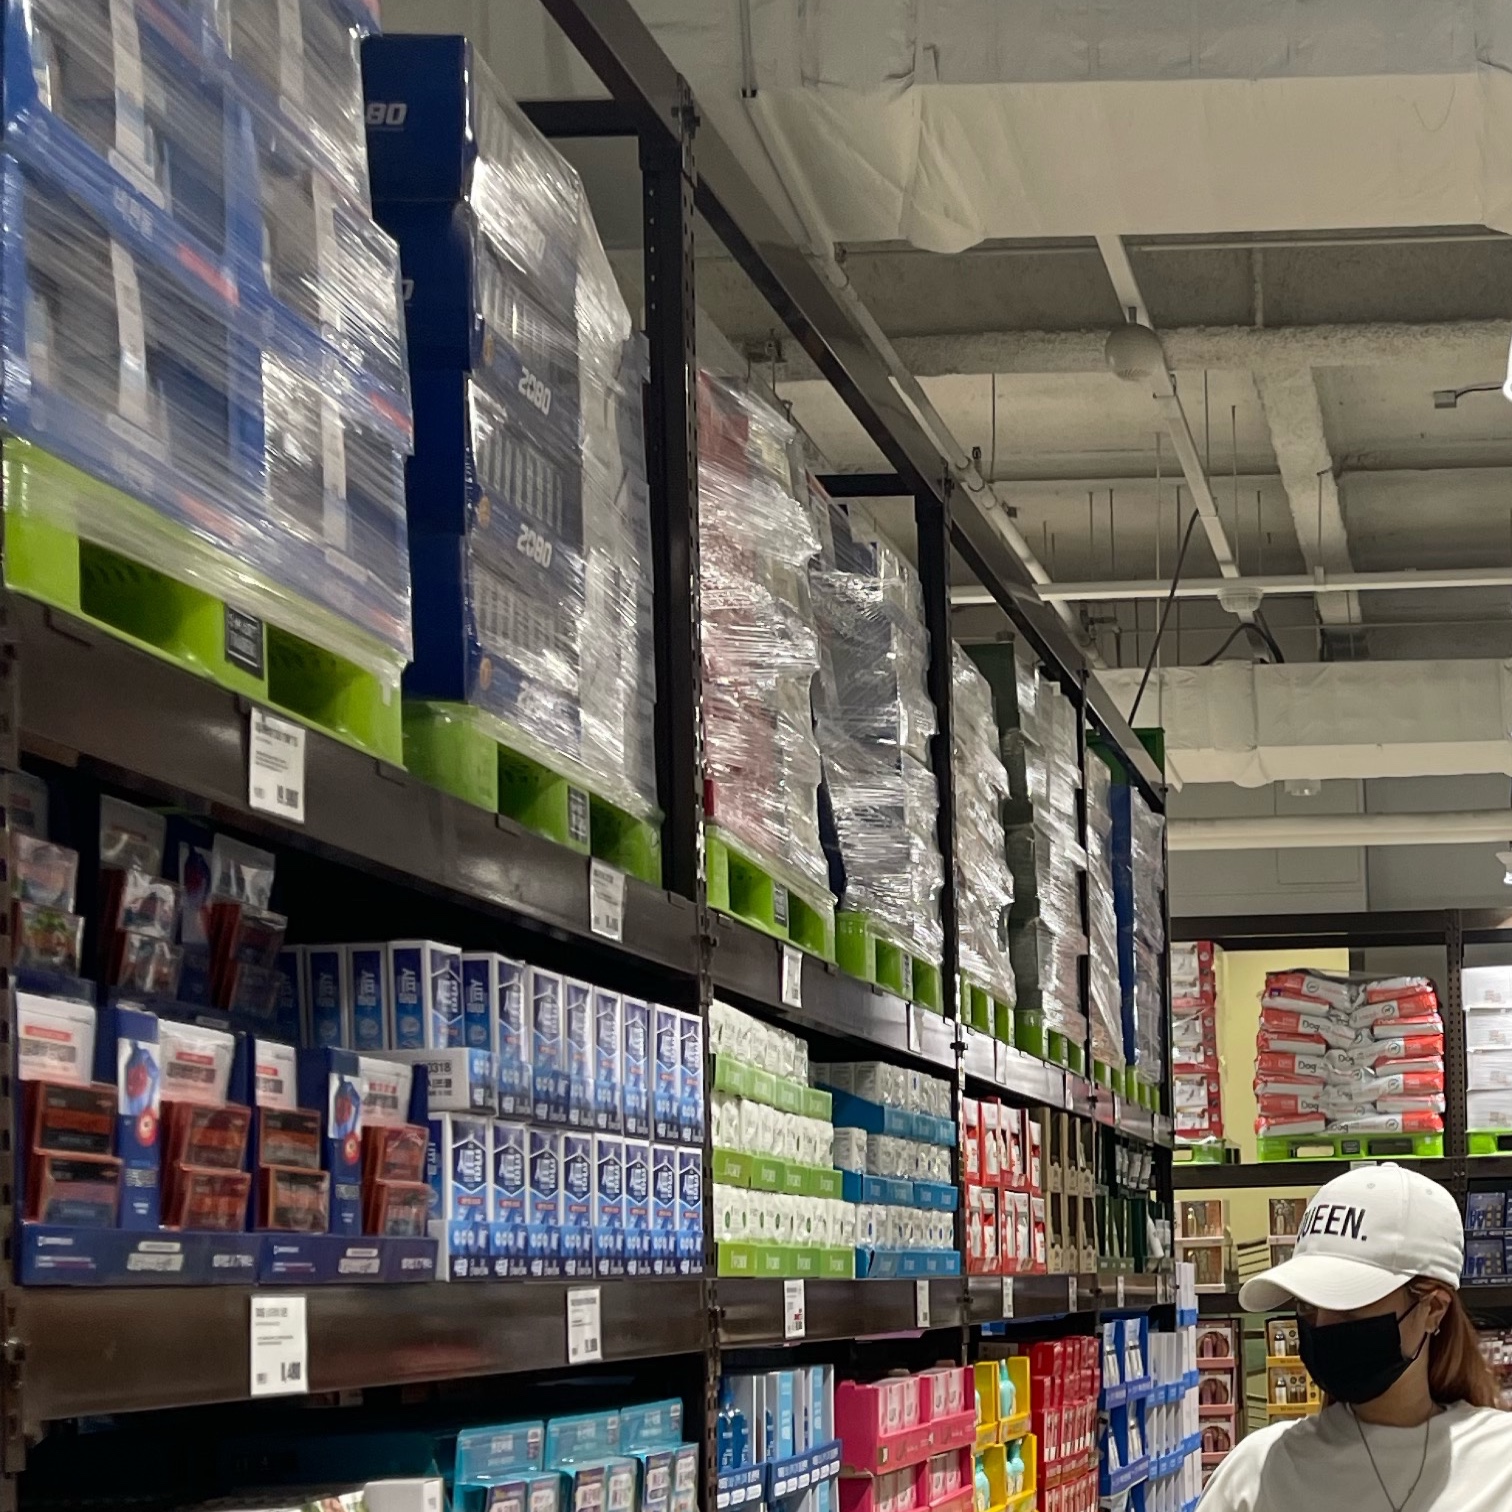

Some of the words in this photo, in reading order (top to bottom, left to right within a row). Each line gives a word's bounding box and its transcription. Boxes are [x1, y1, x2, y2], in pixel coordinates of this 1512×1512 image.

[519, 366, 552, 416] 2080
[517, 524, 552, 568] 2080
[1302, 1018, 1321, 1033] Dog
[1298, 1060, 1317, 1074] Dog
[1338, 1053, 1356, 1066] Dog
[1301, 1100, 1320, 1114] Dog
[1297, 1203, 1368, 1245] UEEN.
